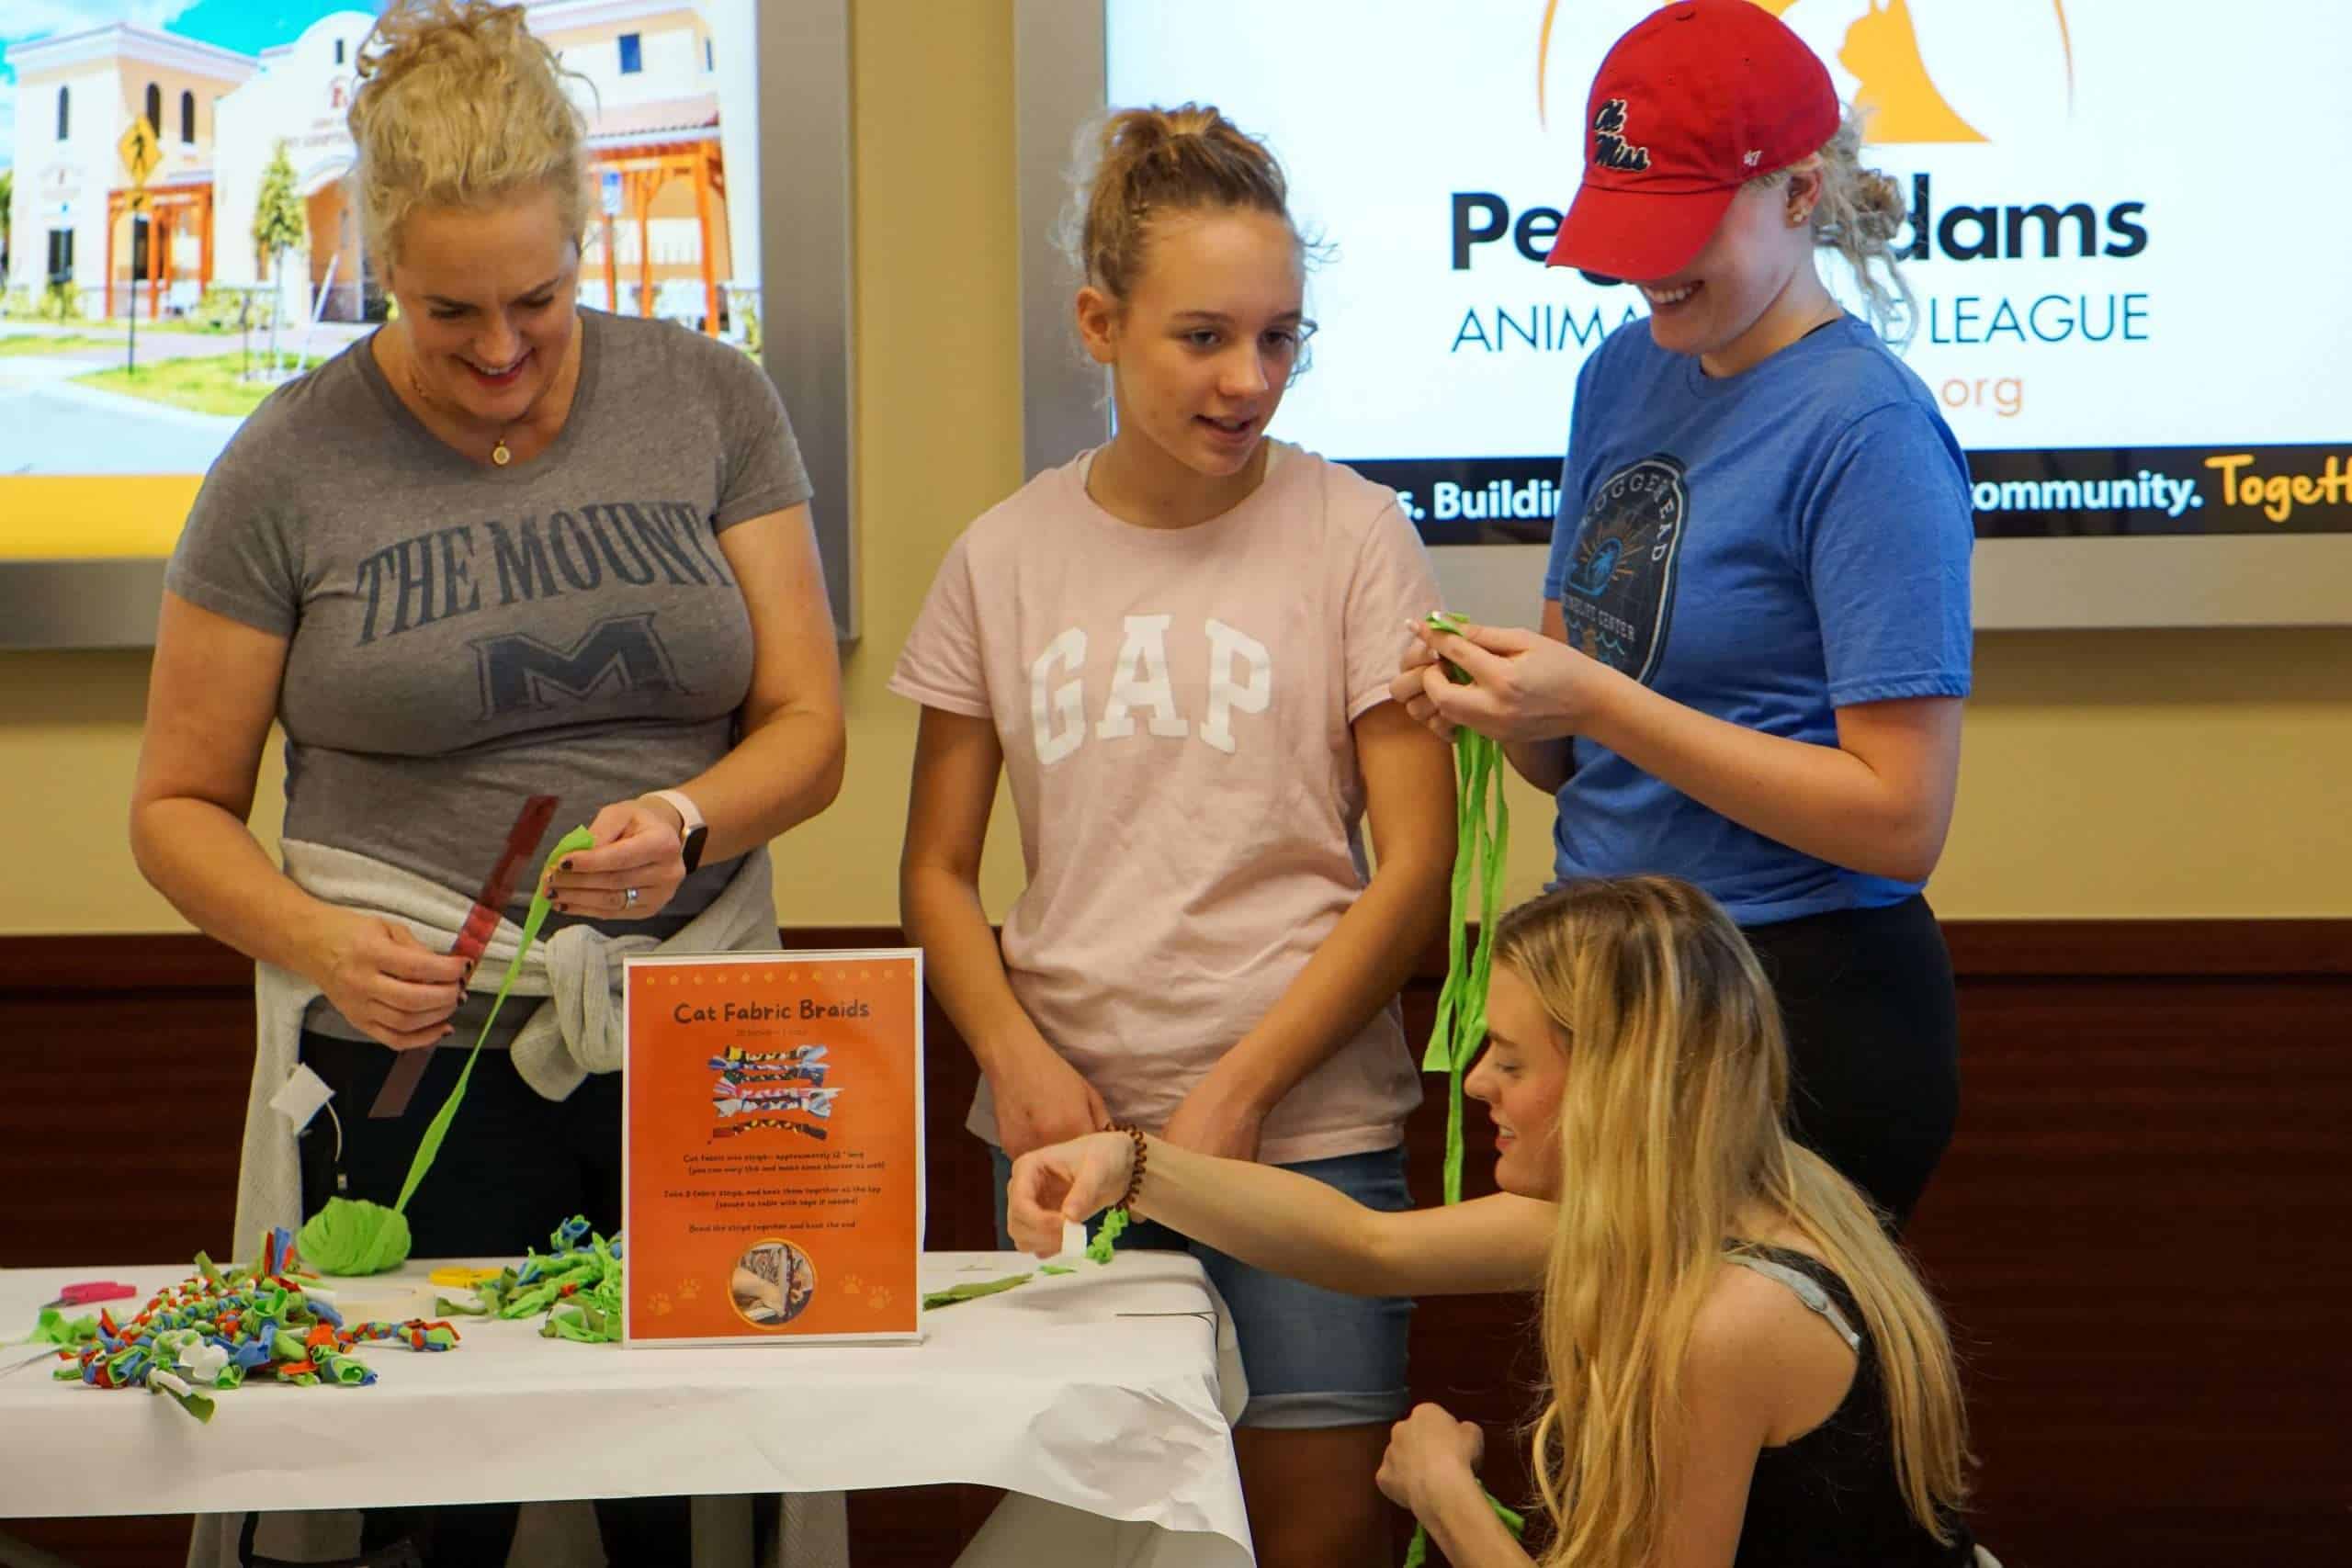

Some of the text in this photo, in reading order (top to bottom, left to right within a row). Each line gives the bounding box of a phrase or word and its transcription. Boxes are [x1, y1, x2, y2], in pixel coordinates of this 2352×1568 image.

[1594, 131, 1651, 172] Miss
[1894, 172, 2148, 261] dams
[1930, 294, 2149, 344] LEAGUE
[1941, 378, 2026, 418] org
[1970, 469, 2204, 518] ommunity.
[356, 501, 733, 646] THE MOUNT
[463, 610, 694, 723] M
[1031, 613, 1272, 765] GAP
[673, 998, 870, 1024] Cat Fabric Braids
